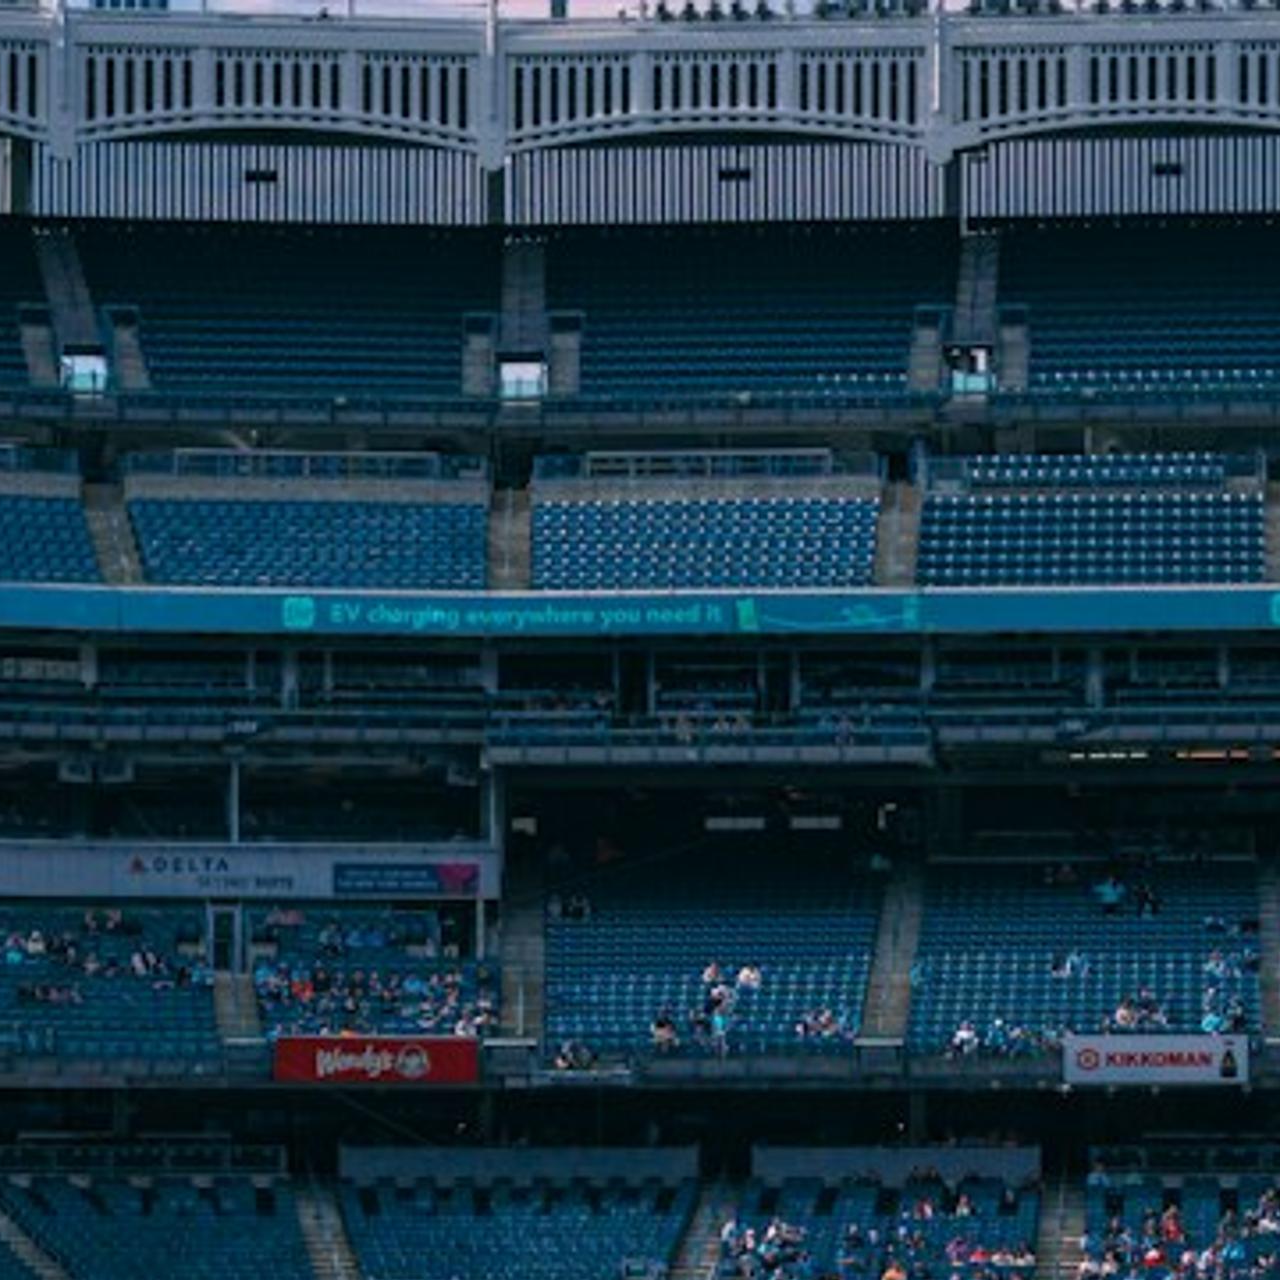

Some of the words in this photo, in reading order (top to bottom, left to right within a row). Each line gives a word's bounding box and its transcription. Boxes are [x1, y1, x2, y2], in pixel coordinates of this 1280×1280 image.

[330, 603, 358, 623] EV
[366, 603, 459, 630] charging
[600, 609, 640, 632] you
[152, 857, 229, 873] DELTA
[1106, 1051, 1213, 1067] KIKKOMAN
